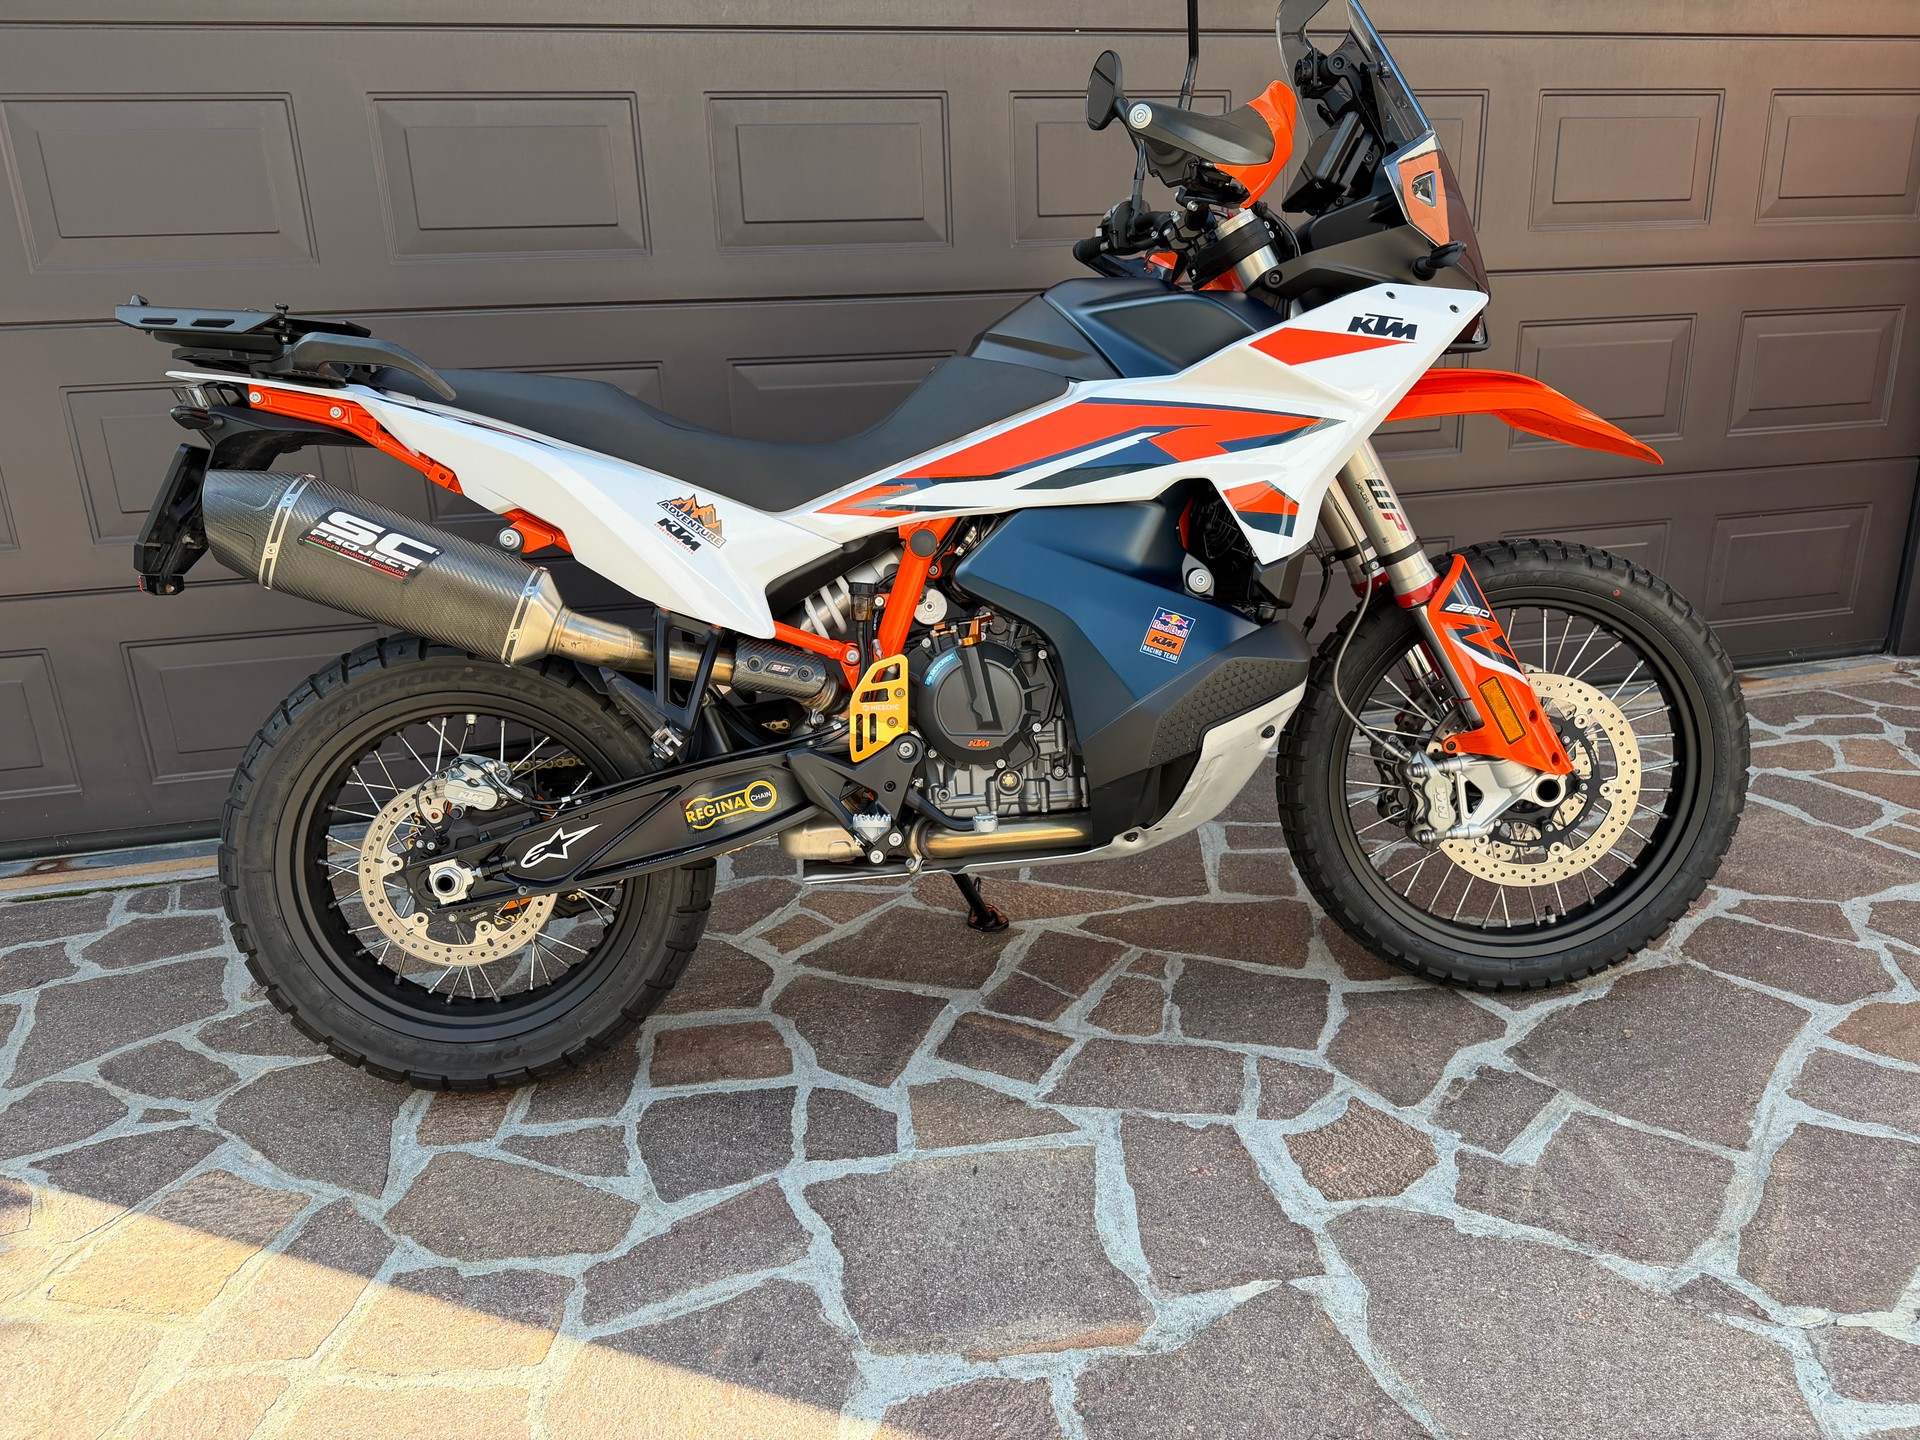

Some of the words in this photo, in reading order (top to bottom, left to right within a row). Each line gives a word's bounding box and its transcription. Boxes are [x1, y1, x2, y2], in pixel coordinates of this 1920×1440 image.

[1347, 313, 1418, 340] KTM
[1365, 479, 1408, 531] WP
[317, 511, 438, 567] SC
[657, 517, 702, 551] KTM
[661, 502, 723, 546] ADVENTURE
[306, 535, 340, 551] ADVANCED
[340, 547, 368, 561] EXHAUST
[367, 558, 409, 577] TECHNOLOGY
[310, 528, 415, 571] PROJECT
[1142, 645, 1163, 656] RACING
[1163, 652, 1178, 661] TEAM
[1151, 635, 1178, 649] KTM
[457, 791, 486, 803] KTM
[685, 796, 746, 823] REGINA
[750, 791, 772, 802] CHAIN
